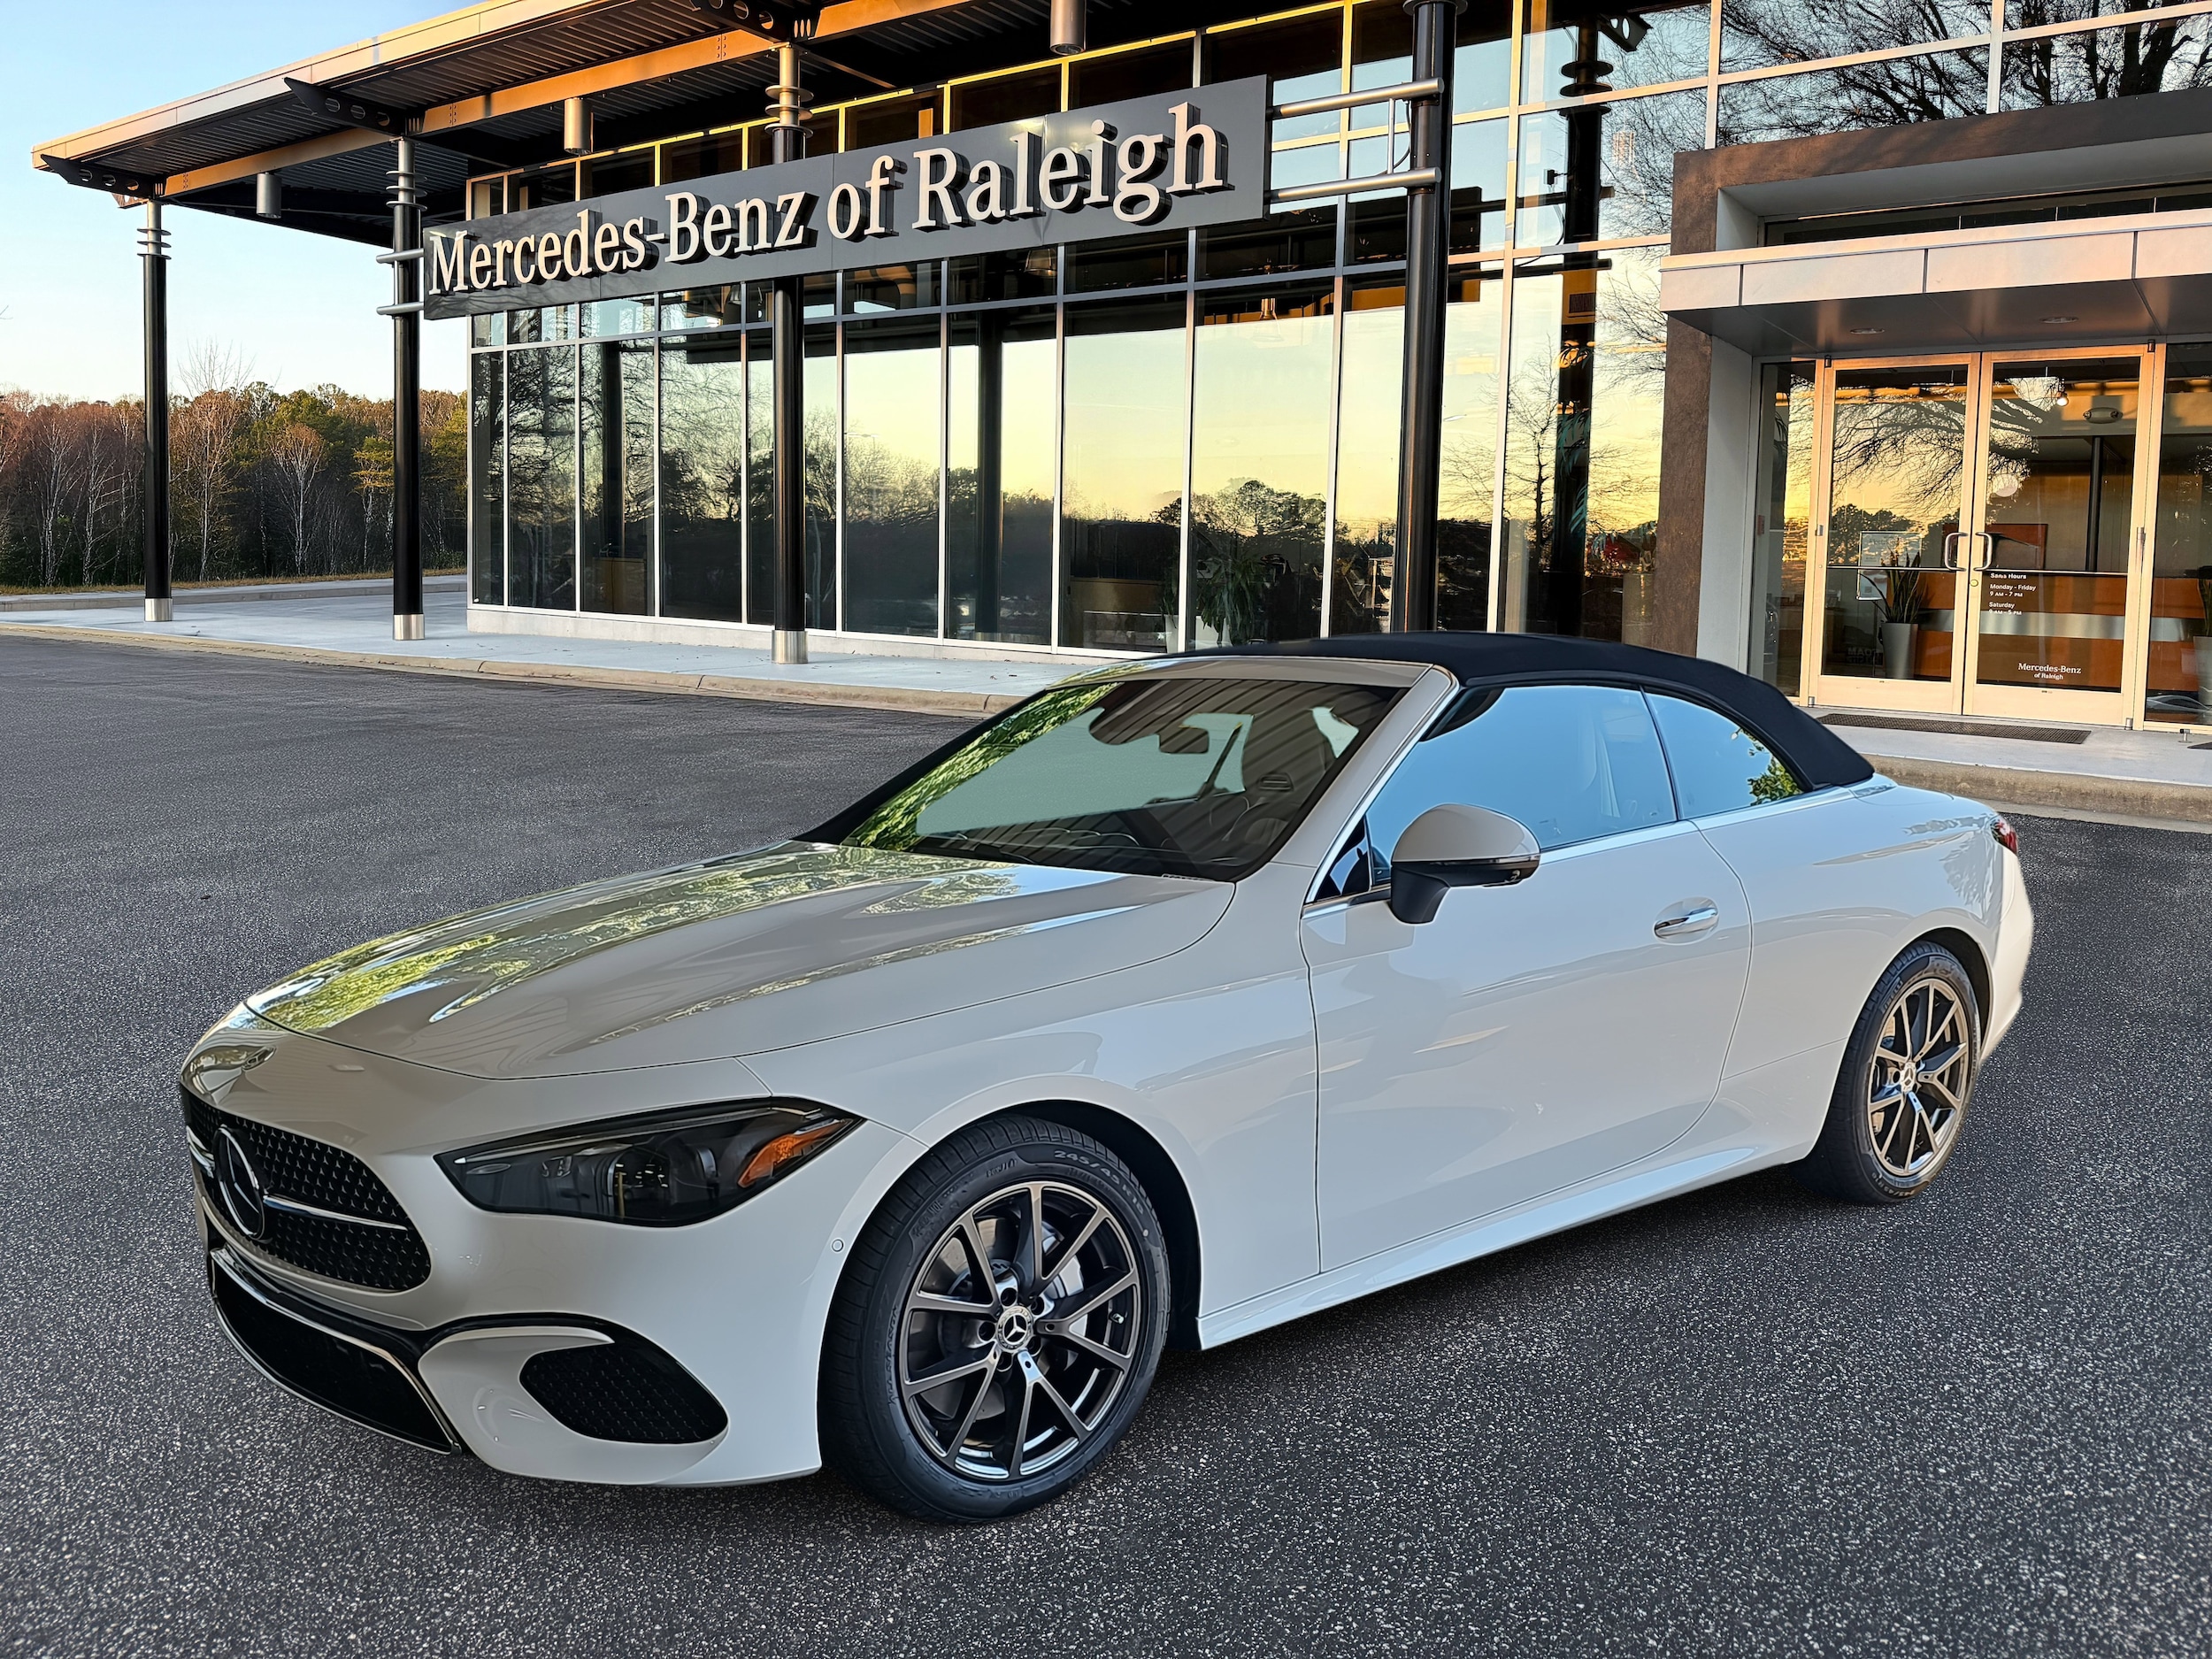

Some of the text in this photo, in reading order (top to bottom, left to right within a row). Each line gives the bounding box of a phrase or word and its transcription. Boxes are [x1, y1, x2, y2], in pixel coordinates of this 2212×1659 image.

[428, 102, 1225, 296] Mercedes-Benz of Raleigh
[2018, 663, 2081, 673] Mercedes-Benz
